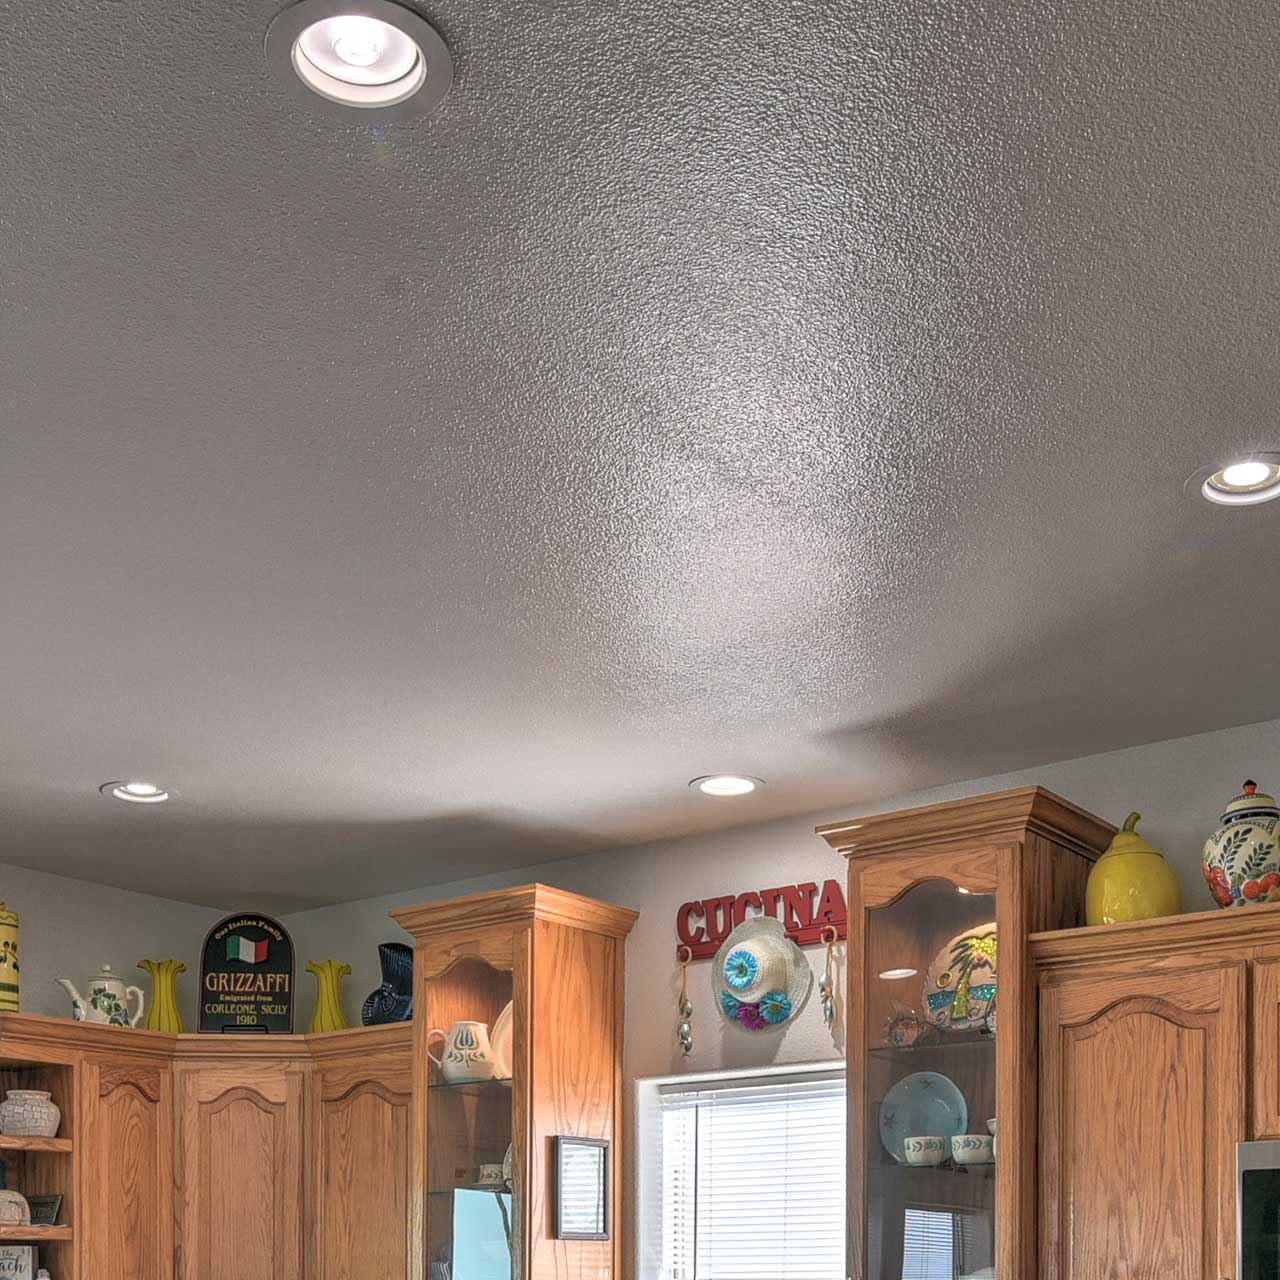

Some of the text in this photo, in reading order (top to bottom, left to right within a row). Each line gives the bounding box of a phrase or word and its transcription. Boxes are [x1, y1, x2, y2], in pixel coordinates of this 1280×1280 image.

[676, 879, 847, 945] CUCINA
[215, 919, 284, 941] Our Italian Family
[206, 972, 289, 992] GRIZZAFFI
[219, 994, 273, 1002] Emigrated from
[261, 1003, 288, 1015] SICILY
[236, 1015, 257, 1025] 1910
